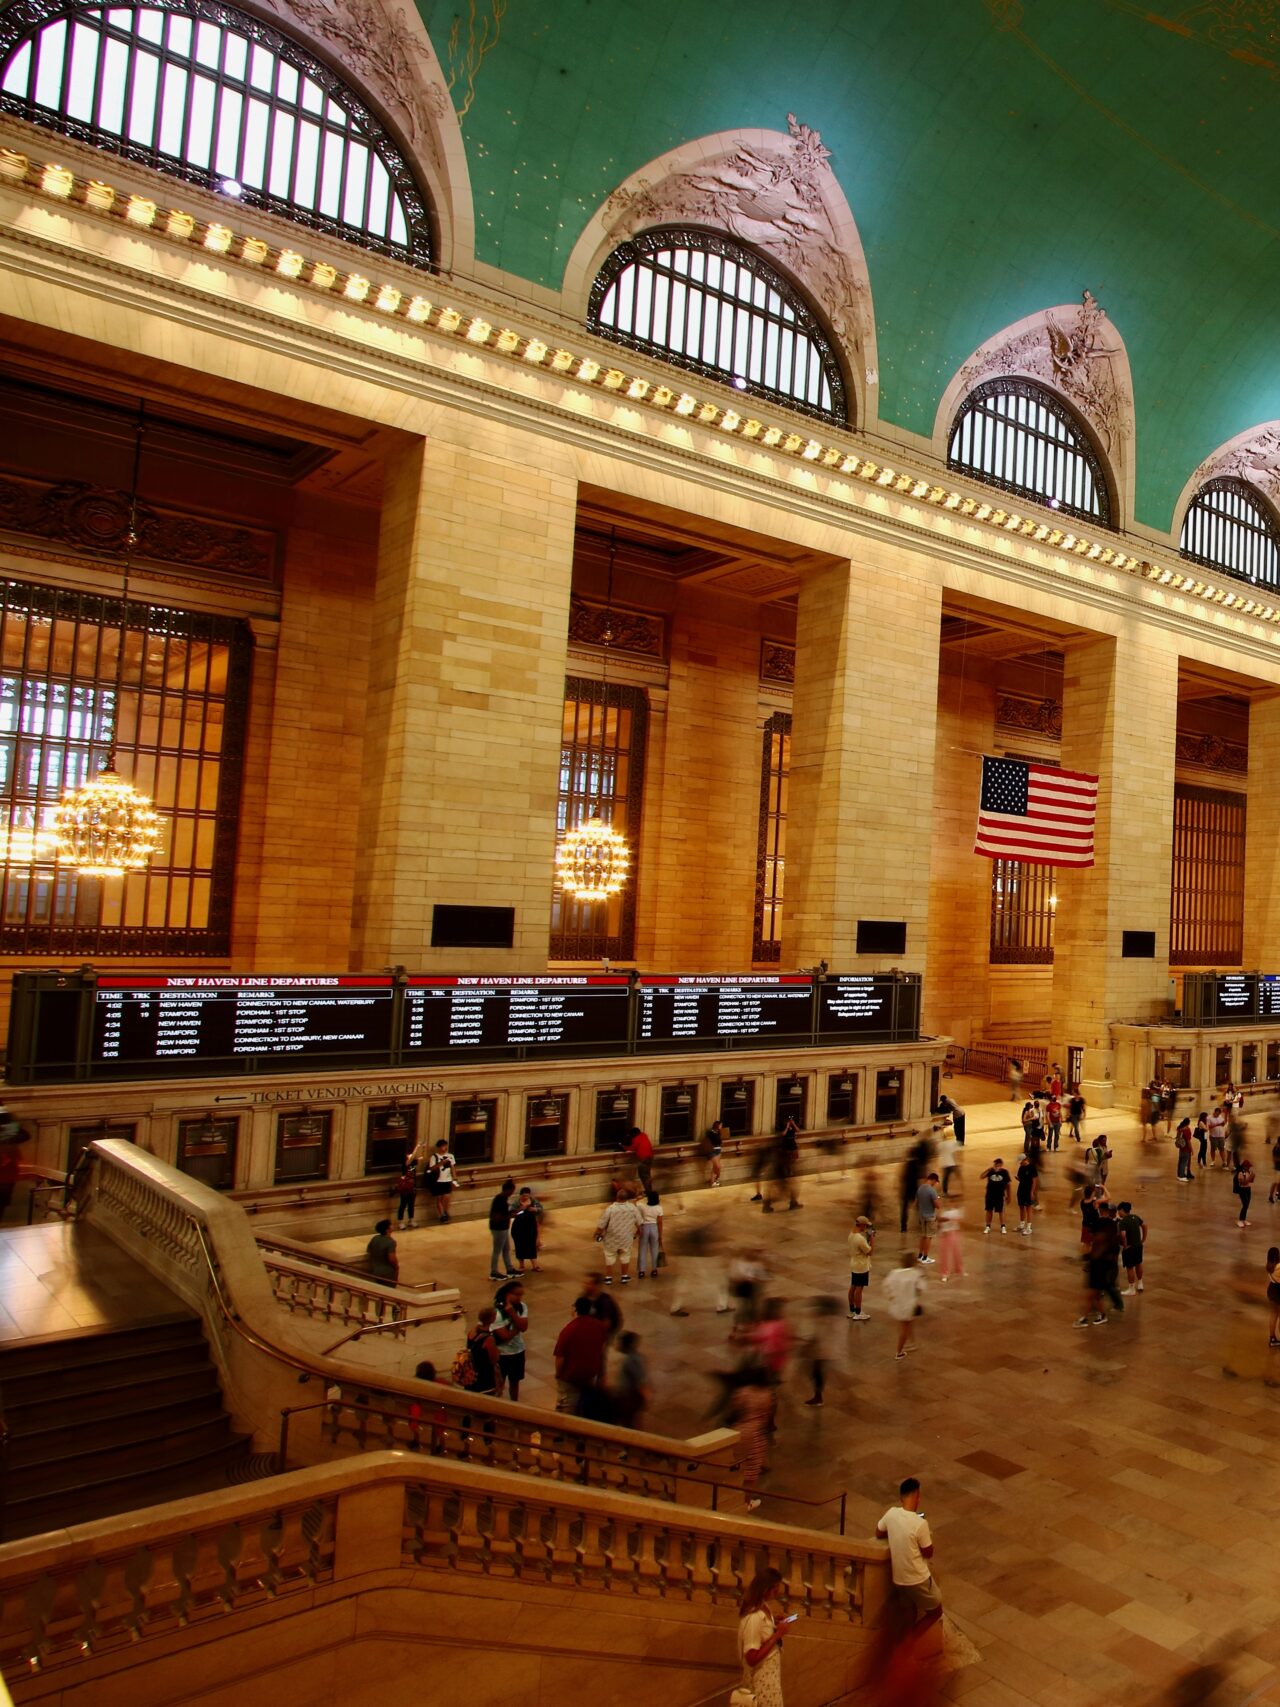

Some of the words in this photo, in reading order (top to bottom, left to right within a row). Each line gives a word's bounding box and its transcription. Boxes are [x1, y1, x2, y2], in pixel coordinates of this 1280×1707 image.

[251, 1090, 302, 1102] TICKET
[307, 1086, 372, 1099] VENDING
[376, 1082, 444, 1095] MACHINES
